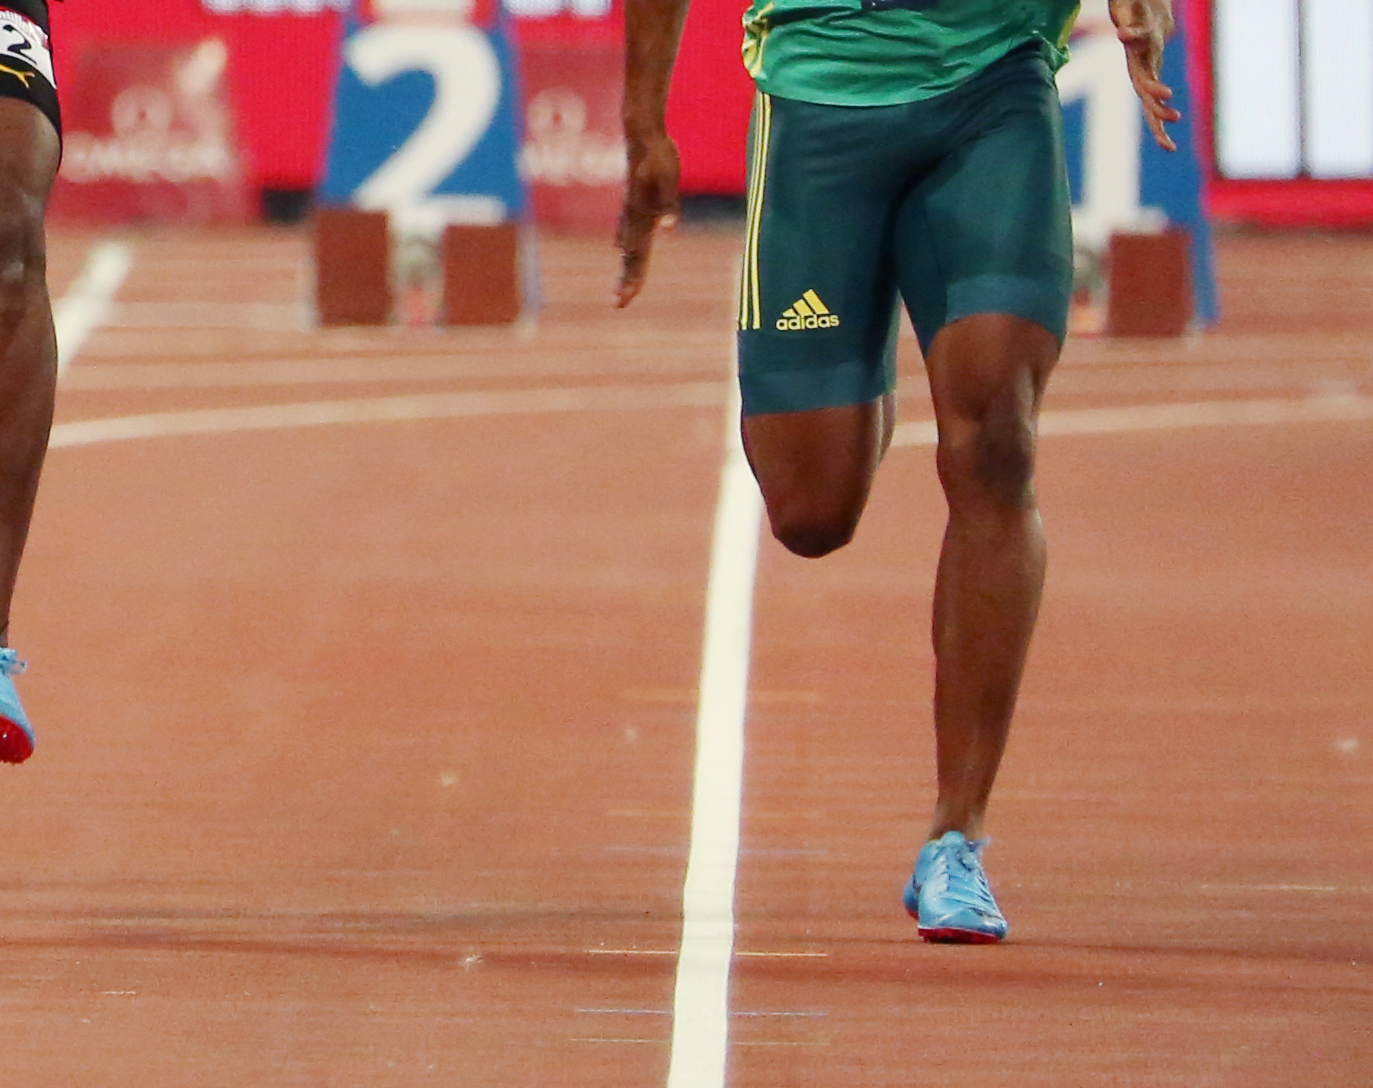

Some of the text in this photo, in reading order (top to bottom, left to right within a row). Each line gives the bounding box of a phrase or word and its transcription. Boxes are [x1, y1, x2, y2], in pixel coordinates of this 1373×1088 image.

[2, 23, 38, 66] 2
[344, 23, 509, 226] 2
[775, 314, 840, 331] adidas
